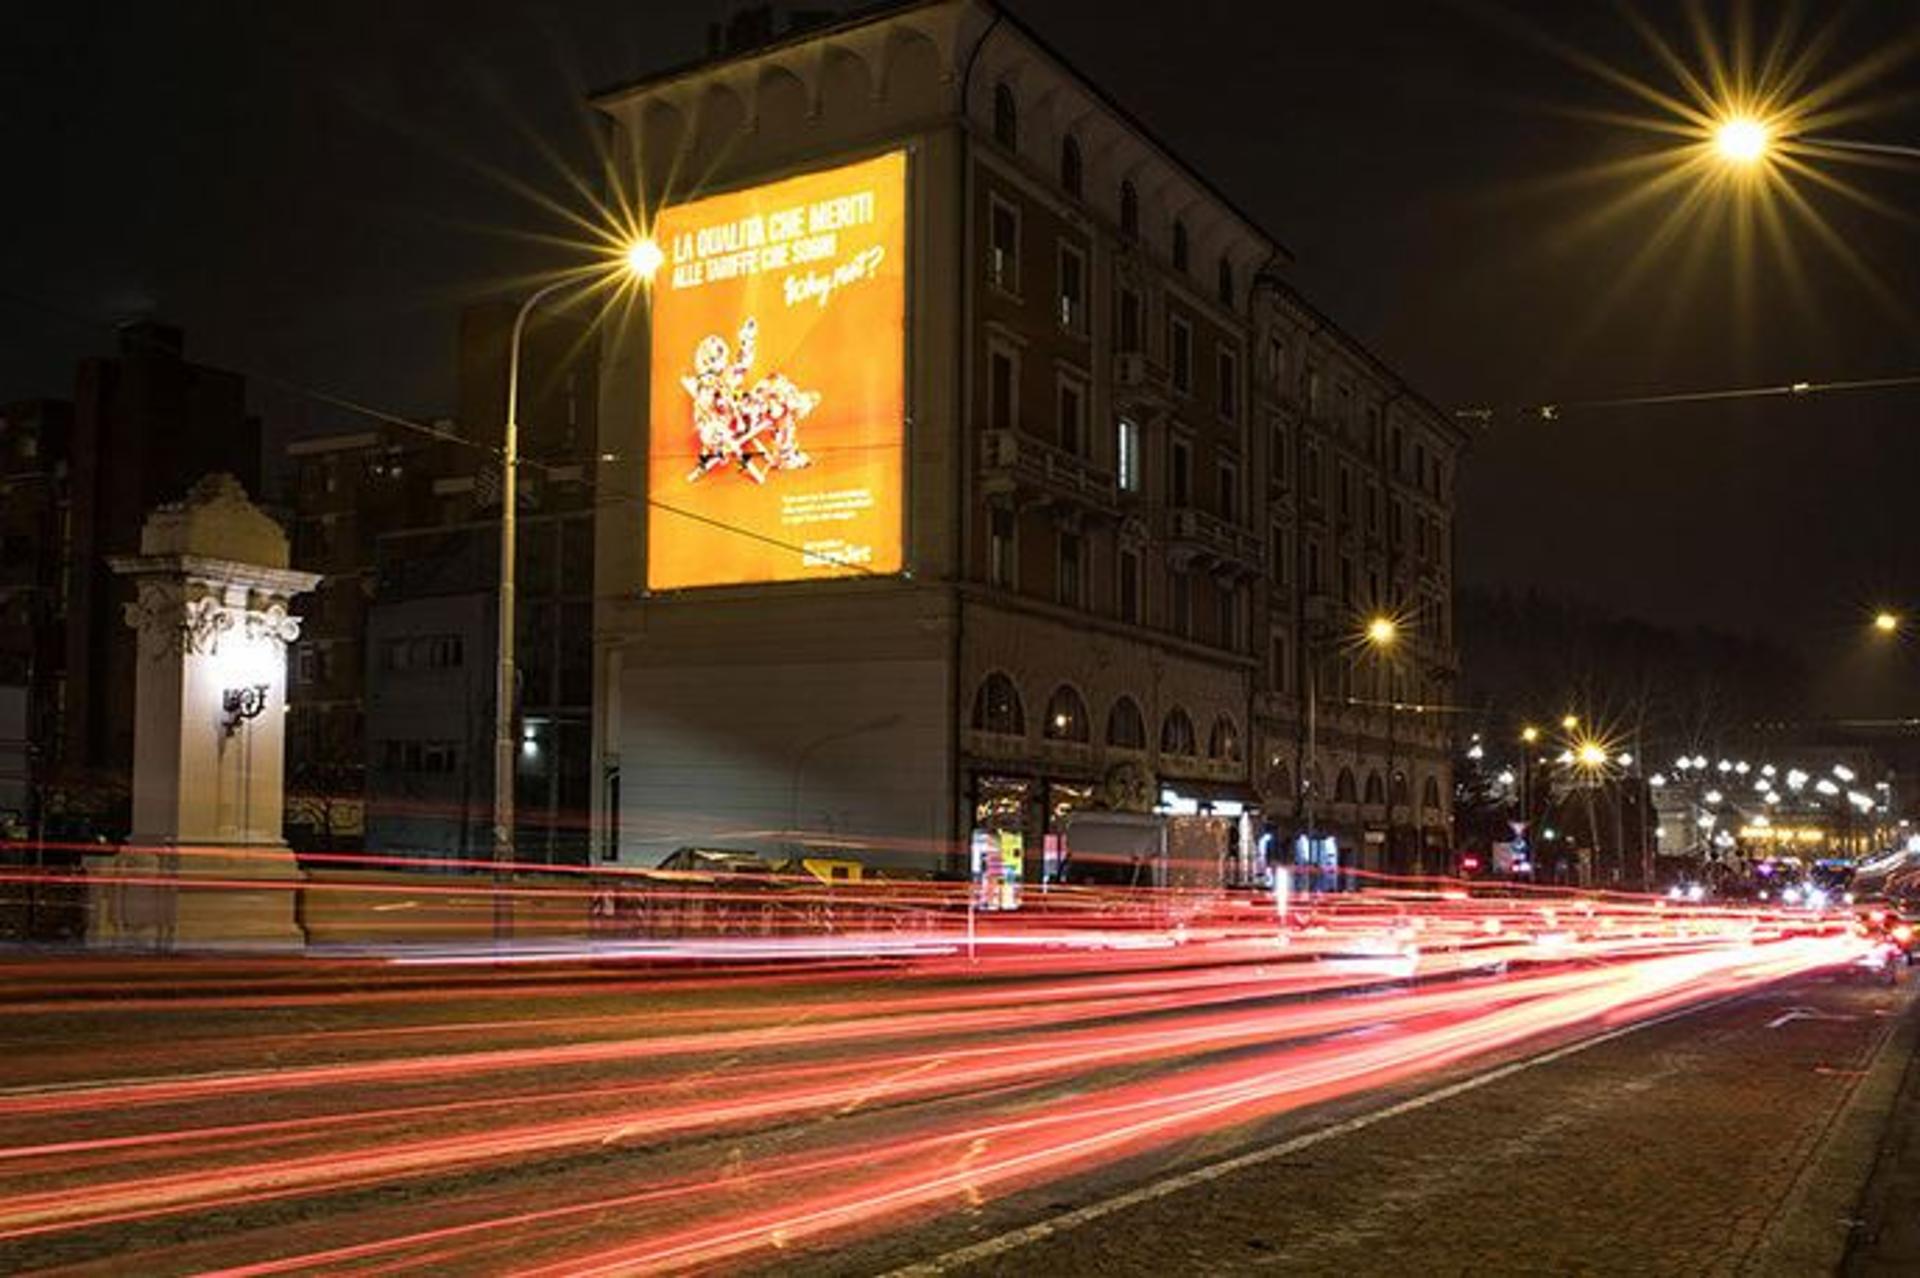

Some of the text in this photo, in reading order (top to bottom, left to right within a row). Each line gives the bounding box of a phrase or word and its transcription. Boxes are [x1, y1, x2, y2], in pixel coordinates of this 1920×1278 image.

[674, 233, 693, 263] LA
[769, 207, 804, 240] CHE
[809, 191, 874, 233] MERITI
[672, 261, 702, 289] ALLE
